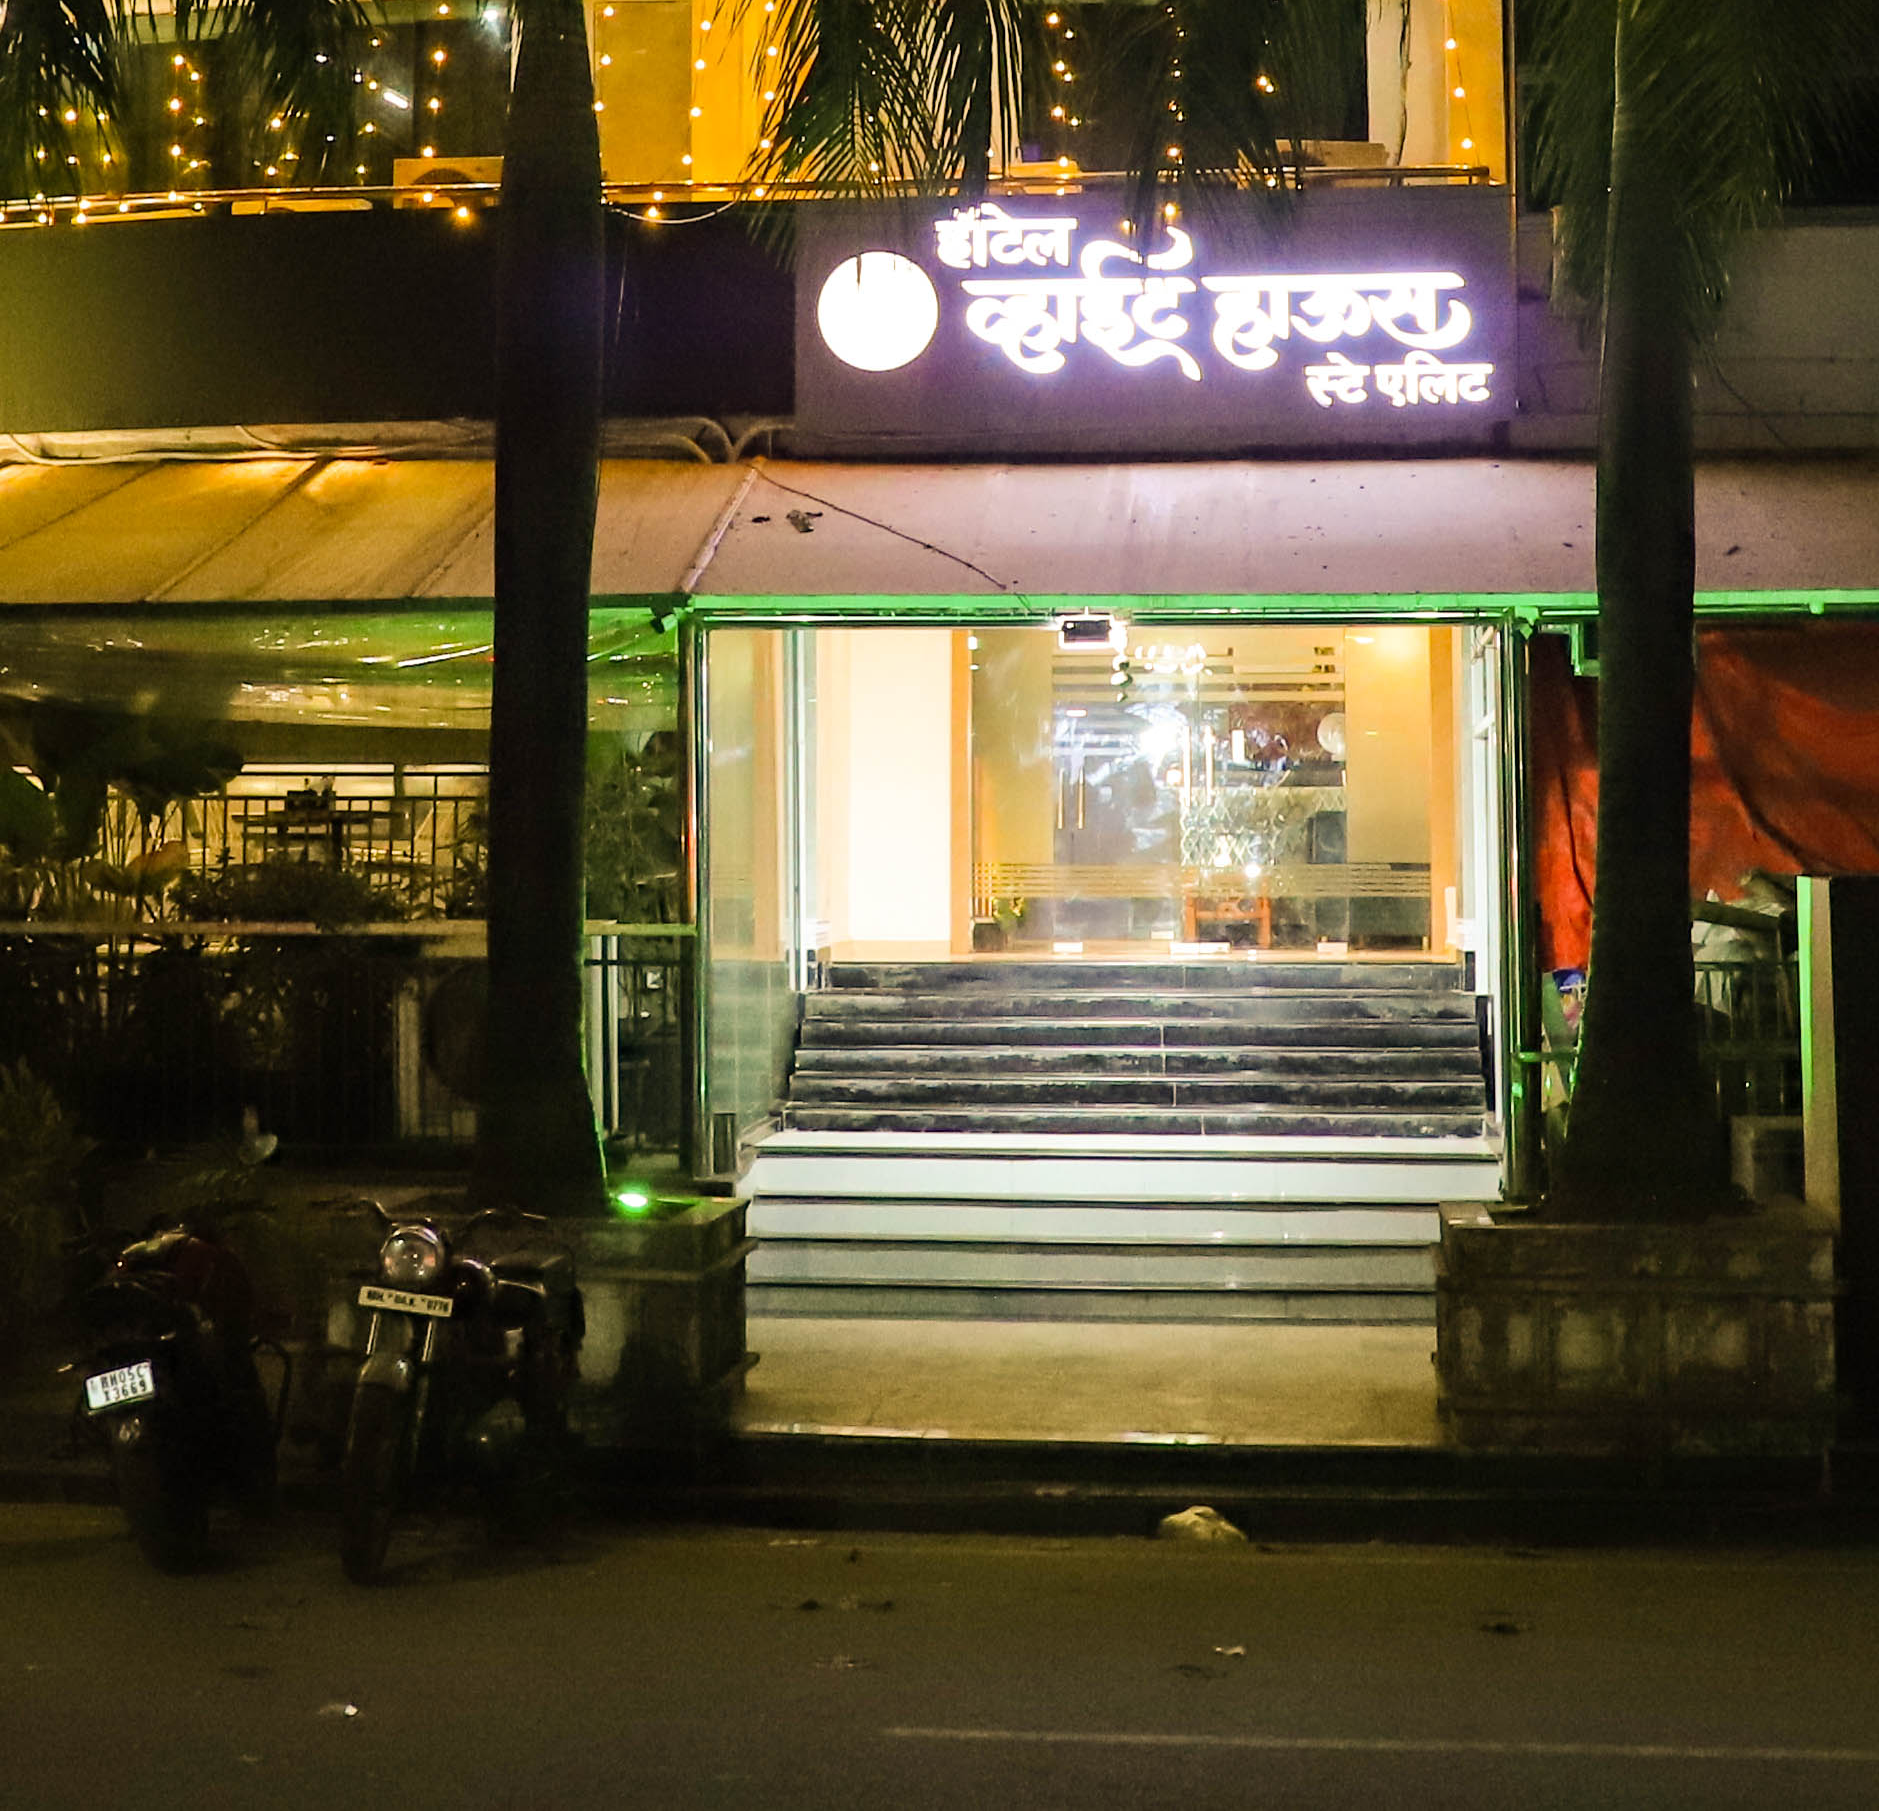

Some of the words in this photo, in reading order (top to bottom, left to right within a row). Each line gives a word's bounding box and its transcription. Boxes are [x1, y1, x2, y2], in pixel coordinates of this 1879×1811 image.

[934, 202, 1078, 270] हॉटेल
[1202, 271, 1472, 372] हाऊस
[1305, 352, 1371, 408] स्टे
[1375, 350, 1495, 407] एलिट
